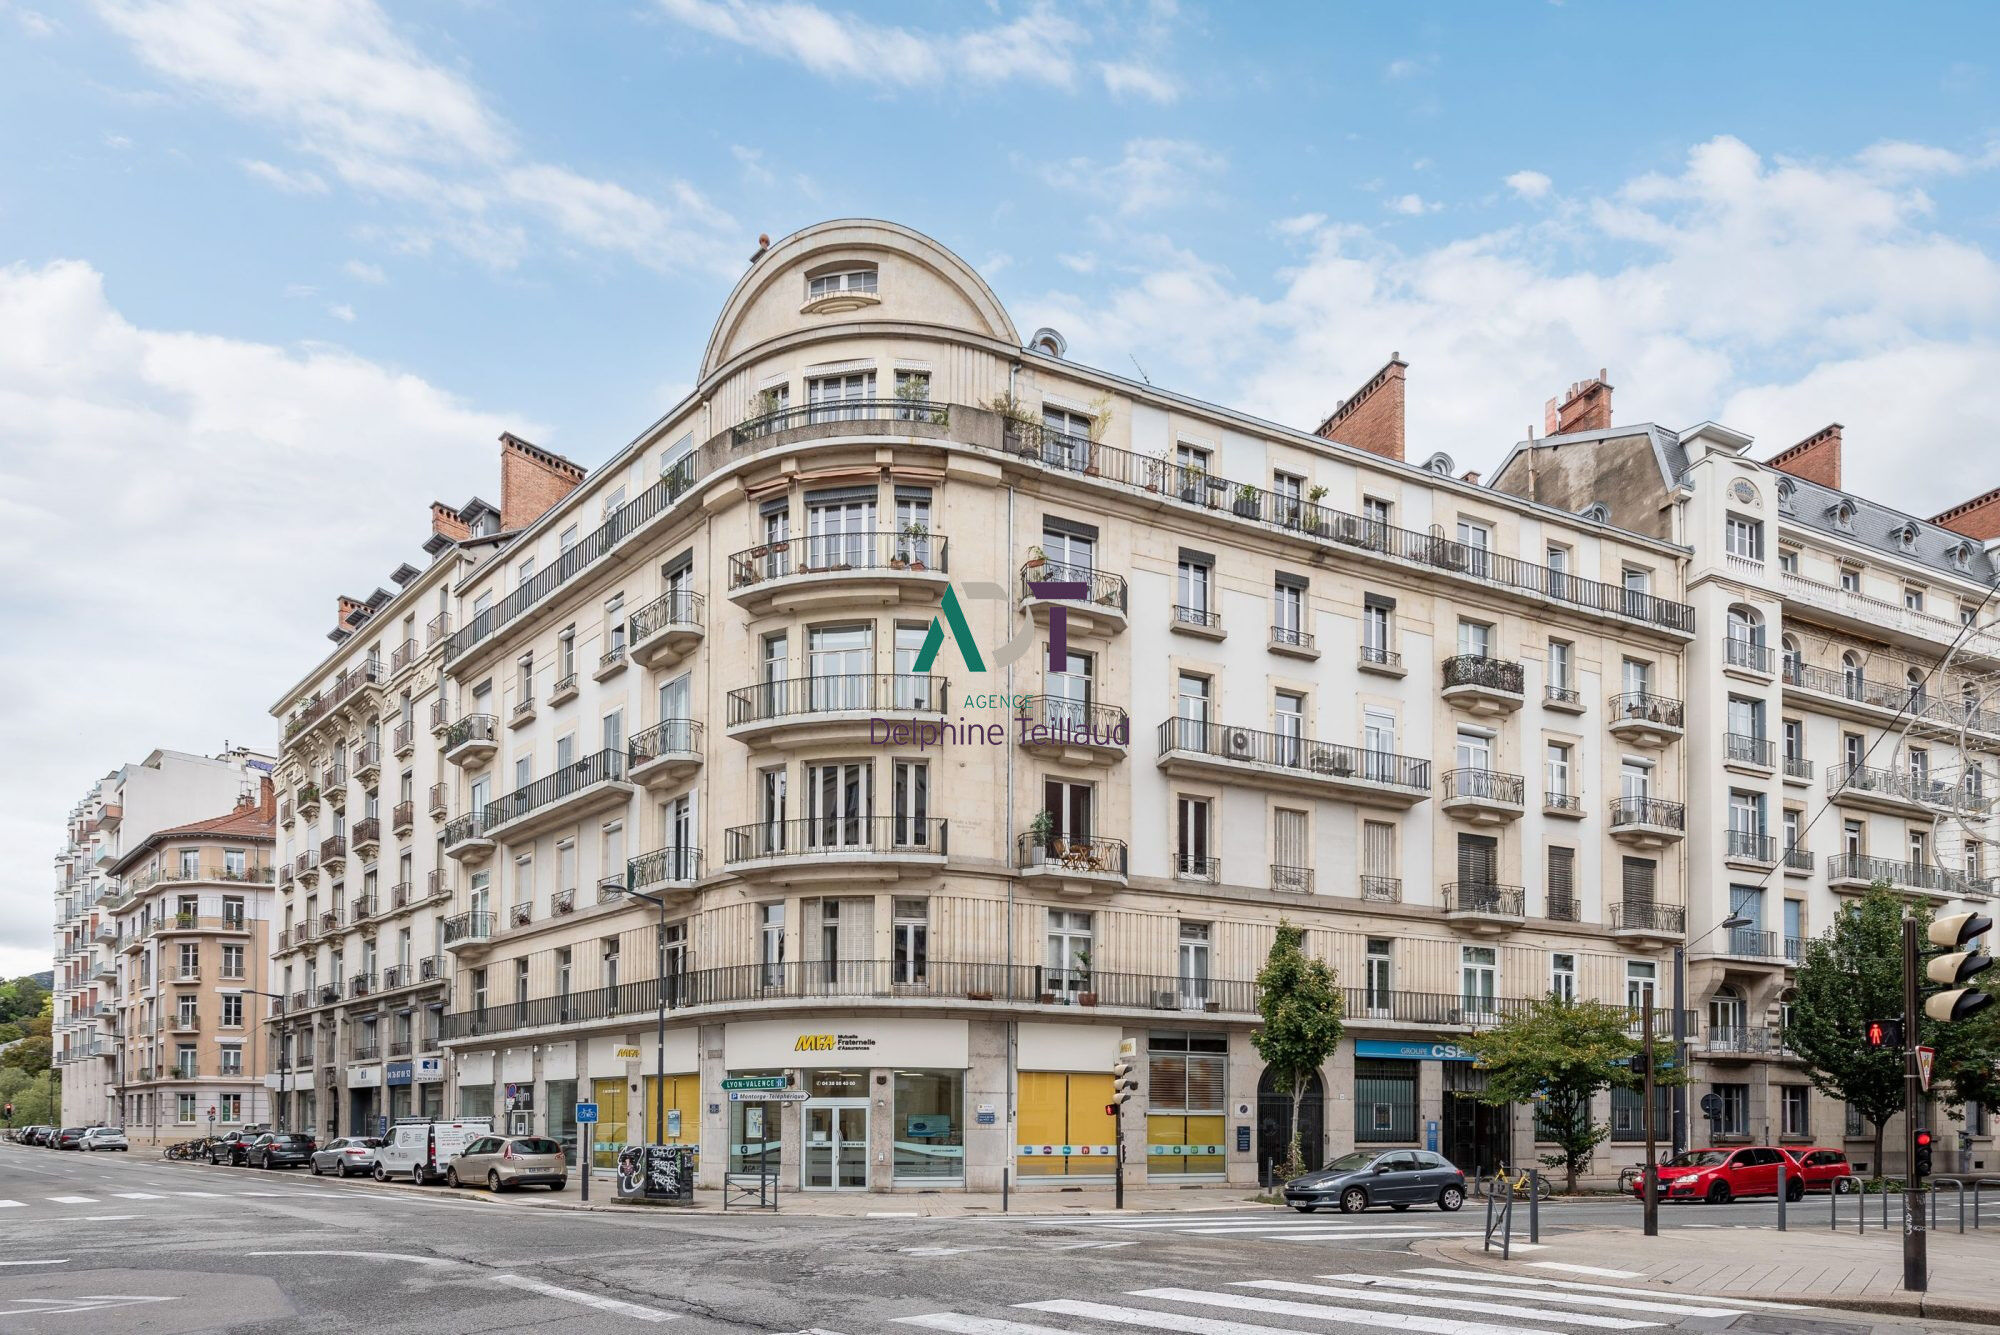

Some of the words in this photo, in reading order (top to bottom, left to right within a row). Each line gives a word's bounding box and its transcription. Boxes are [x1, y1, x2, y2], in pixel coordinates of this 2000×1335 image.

[794, 1034, 836, 1052] MFA
[616, 1048, 640, 1058] MFA
[1400, 1047, 1428, 1056] GROUPE
[726, 1079, 774, 1088] LYON-VALENCE
